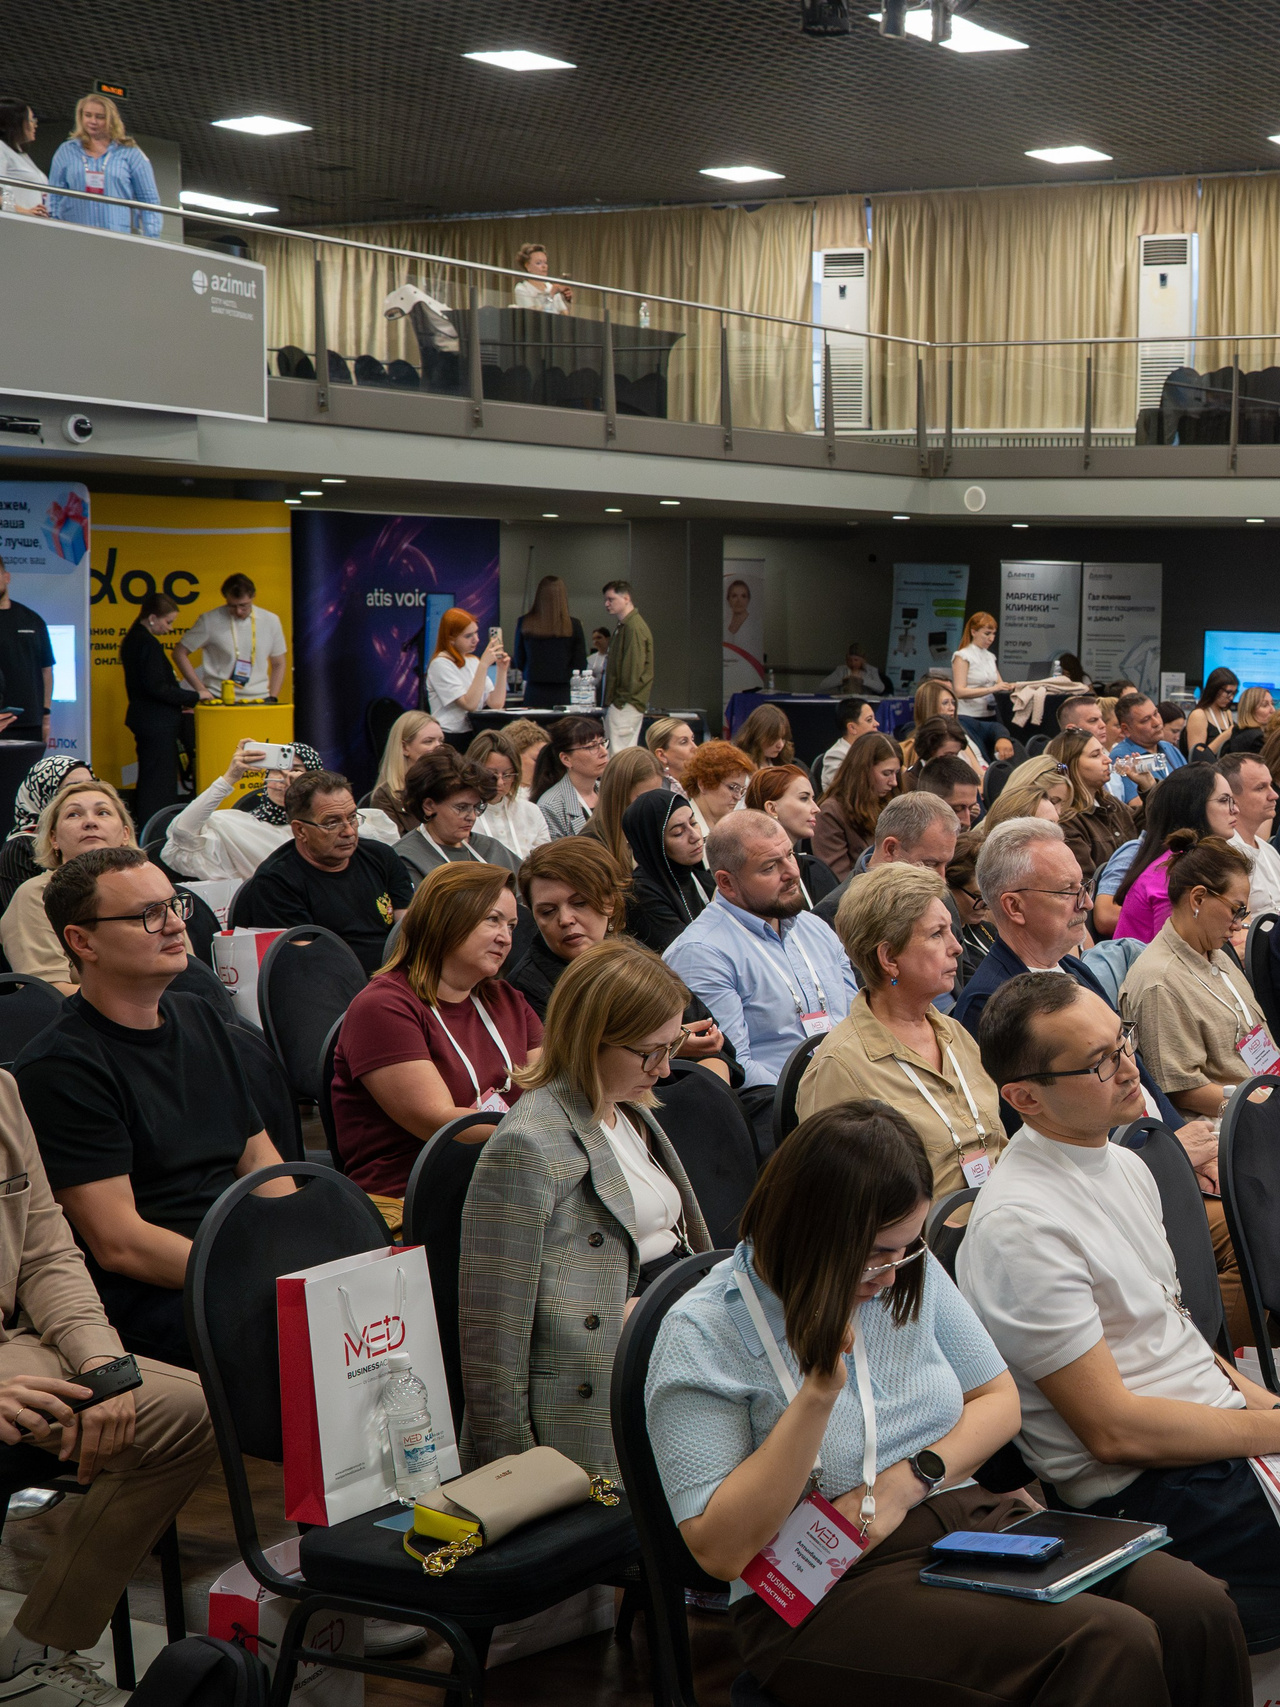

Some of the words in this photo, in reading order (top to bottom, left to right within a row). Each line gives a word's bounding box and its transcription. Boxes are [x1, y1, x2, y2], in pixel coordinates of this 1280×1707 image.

[210, 272, 256, 299] azimut
[366, 588, 393, 607] atis
[1005, 603, 1050, 613] КЛИНИКИ
[1006, 592, 1061, 602] МАРКЕТИНГ
[241, 770, 266, 779] Доку
[343, 1314, 406, 1367] MED
[809, 1520, 840, 1550] MED
[759, 1581, 788, 1609] участник
[766, 1571, 797, 1601] BUSINESS
